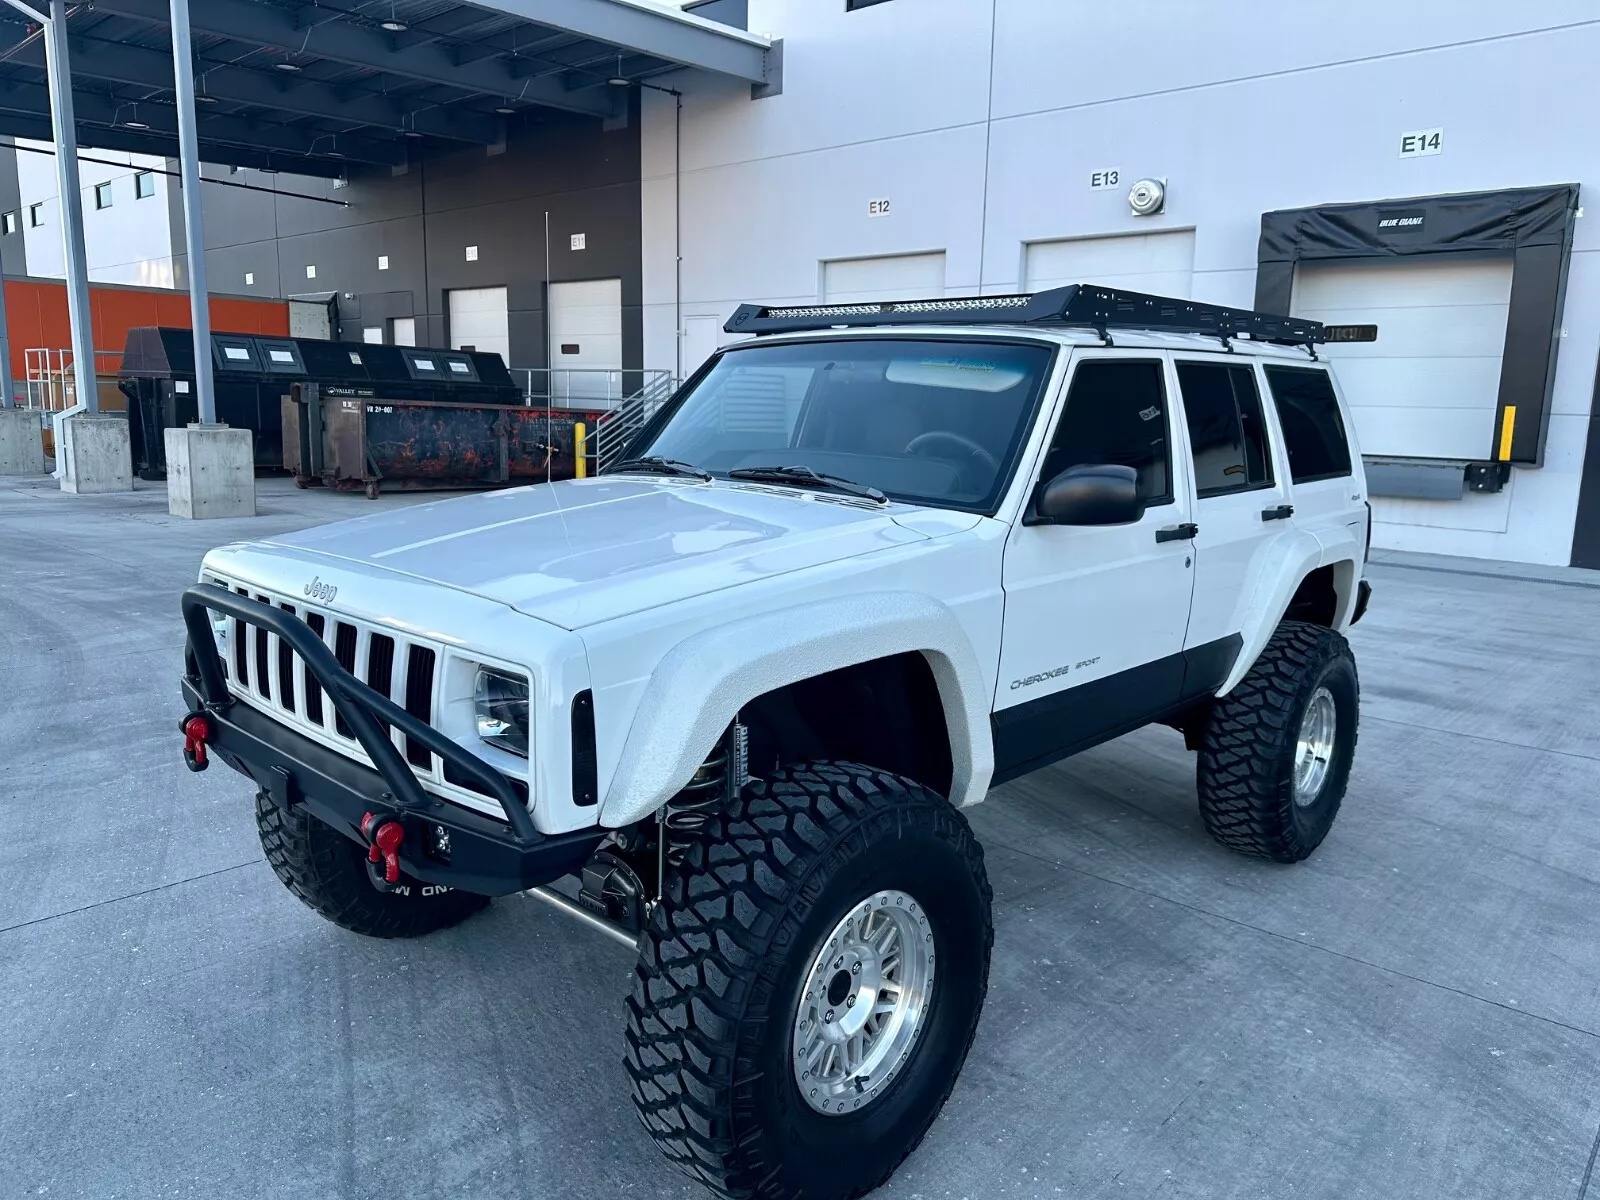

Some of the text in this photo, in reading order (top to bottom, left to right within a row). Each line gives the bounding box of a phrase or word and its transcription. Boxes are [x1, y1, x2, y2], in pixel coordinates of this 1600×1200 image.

[1401, 132, 1441, 153] E14
[1091, 171, 1119, 187] E13
[869, 200, 890, 213] E12
[1379, 217, 1423, 227] BLUE GIANT
[572, 237, 584, 247] E11
[303, 575, 338, 606] Jeep
[1010, 656, 1101, 690] CHEROKEE SPORT
